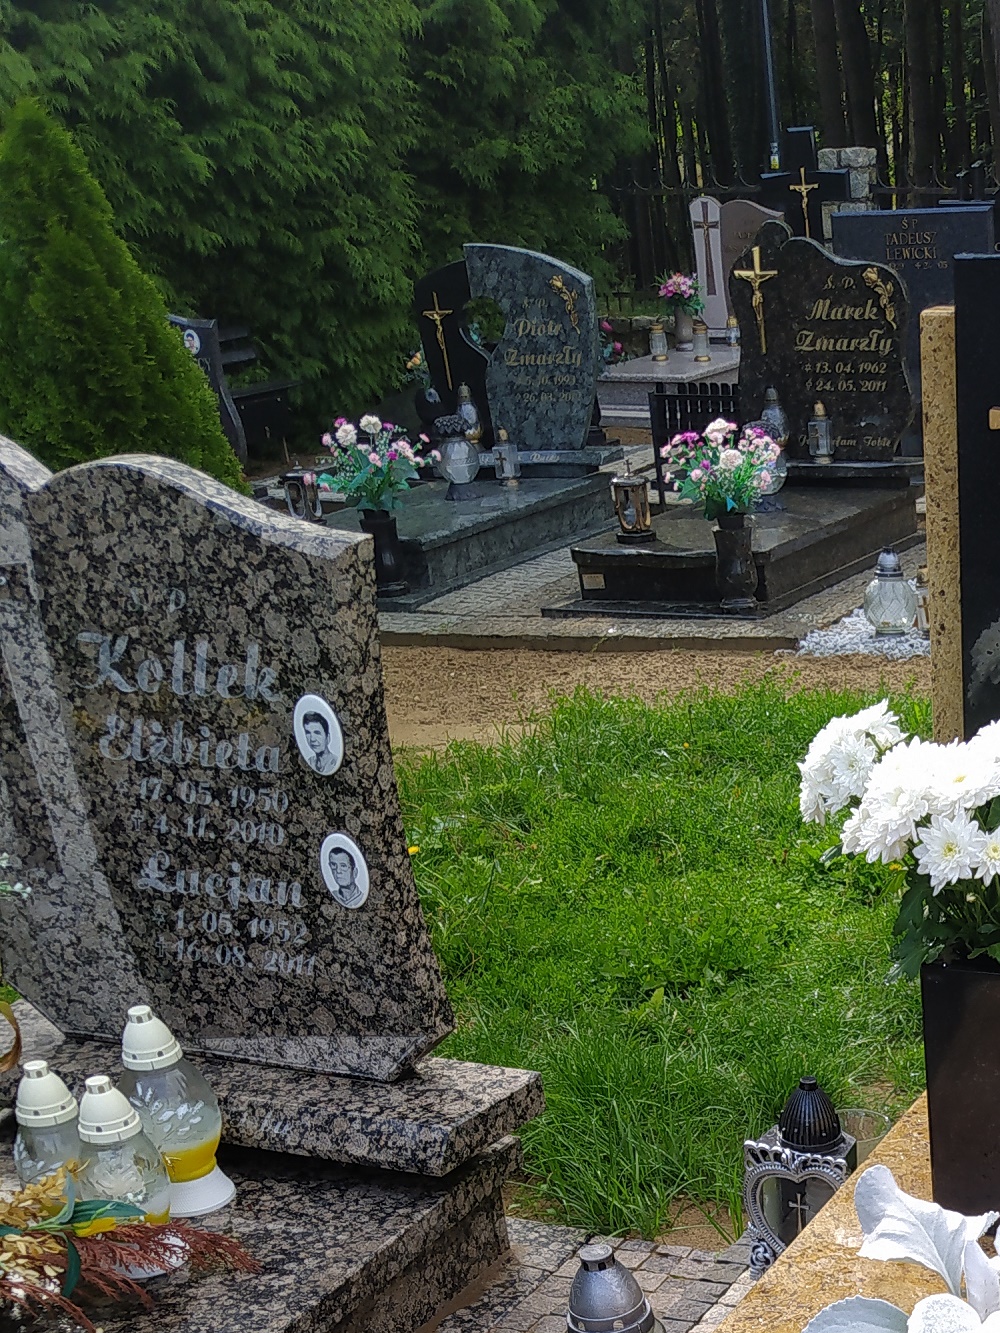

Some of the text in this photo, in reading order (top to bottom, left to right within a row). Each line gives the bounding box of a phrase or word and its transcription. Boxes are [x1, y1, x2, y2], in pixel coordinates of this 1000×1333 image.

[883, 231, 938, 246] TADEUSZ
[886, 246, 937, 261] LEWICKI
[841, 276, 857, 290] P.
[805, 298, 880, 321] Marek
[512, 317, 563, 337] Piotr
[794, 328, 895, 358] Zmarzły
[815, 361, 888, 374] 13. 04. 1962
[815, 379, 888, 392] 24. 05. 2011
[75, 631, 282, 702] Kollek
[99, 713, 283, 776] Elżbieta
[228, 785, 290, 814] 1950
[225, 817, 286, 846] 2010
[137, 850, 307, 911] Lucjan
